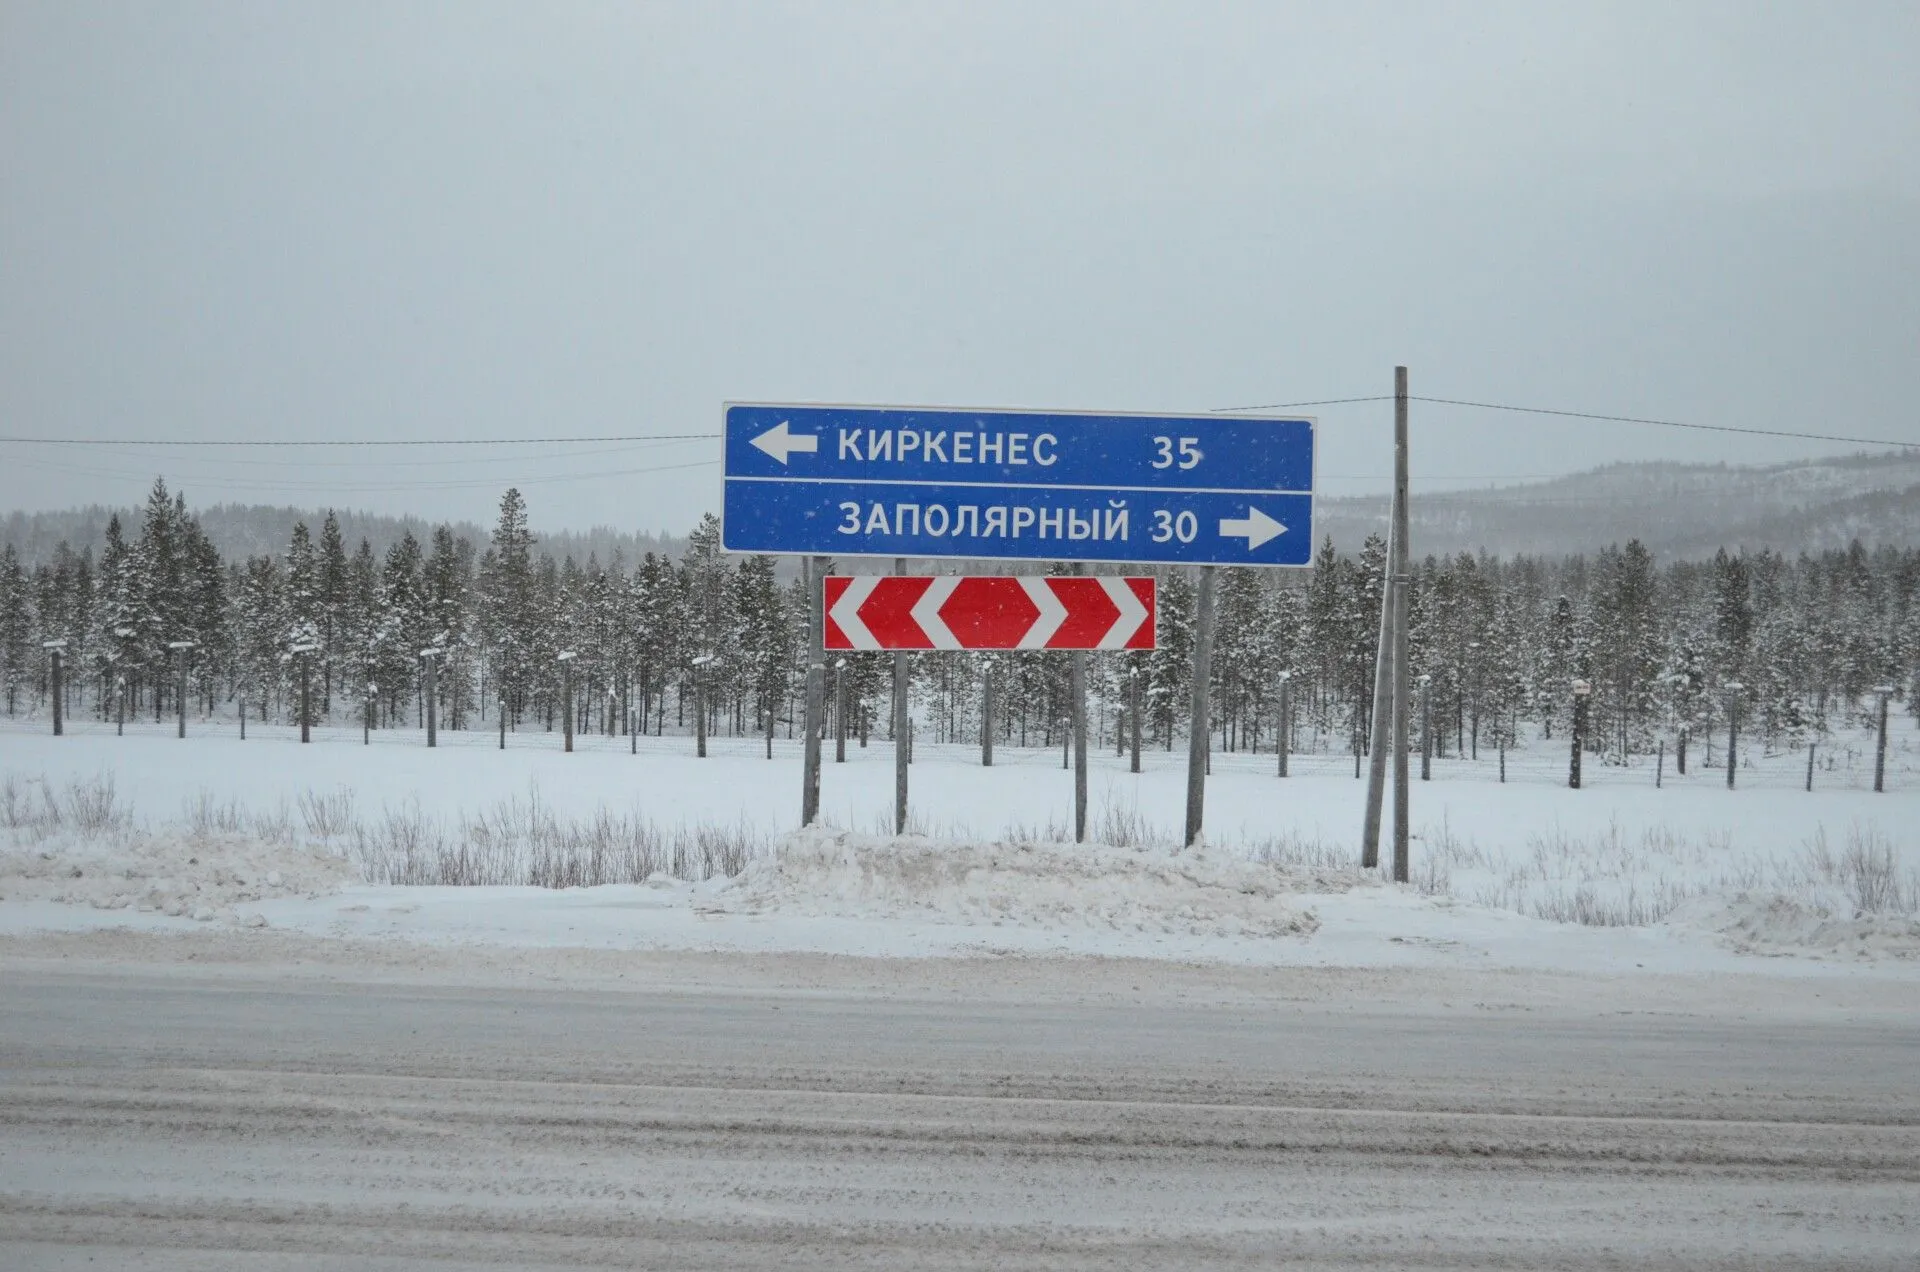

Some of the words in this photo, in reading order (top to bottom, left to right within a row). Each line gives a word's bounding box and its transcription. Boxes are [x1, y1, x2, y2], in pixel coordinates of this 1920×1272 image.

[838, 428, 1058, 466] КИРКЕНЕС
[1152, 436, 1203, 470] 35
[837, 499, 1129, 541] ЗАПОЛЯРНЫЙ
[1152, 509, 1198, 543] 30
